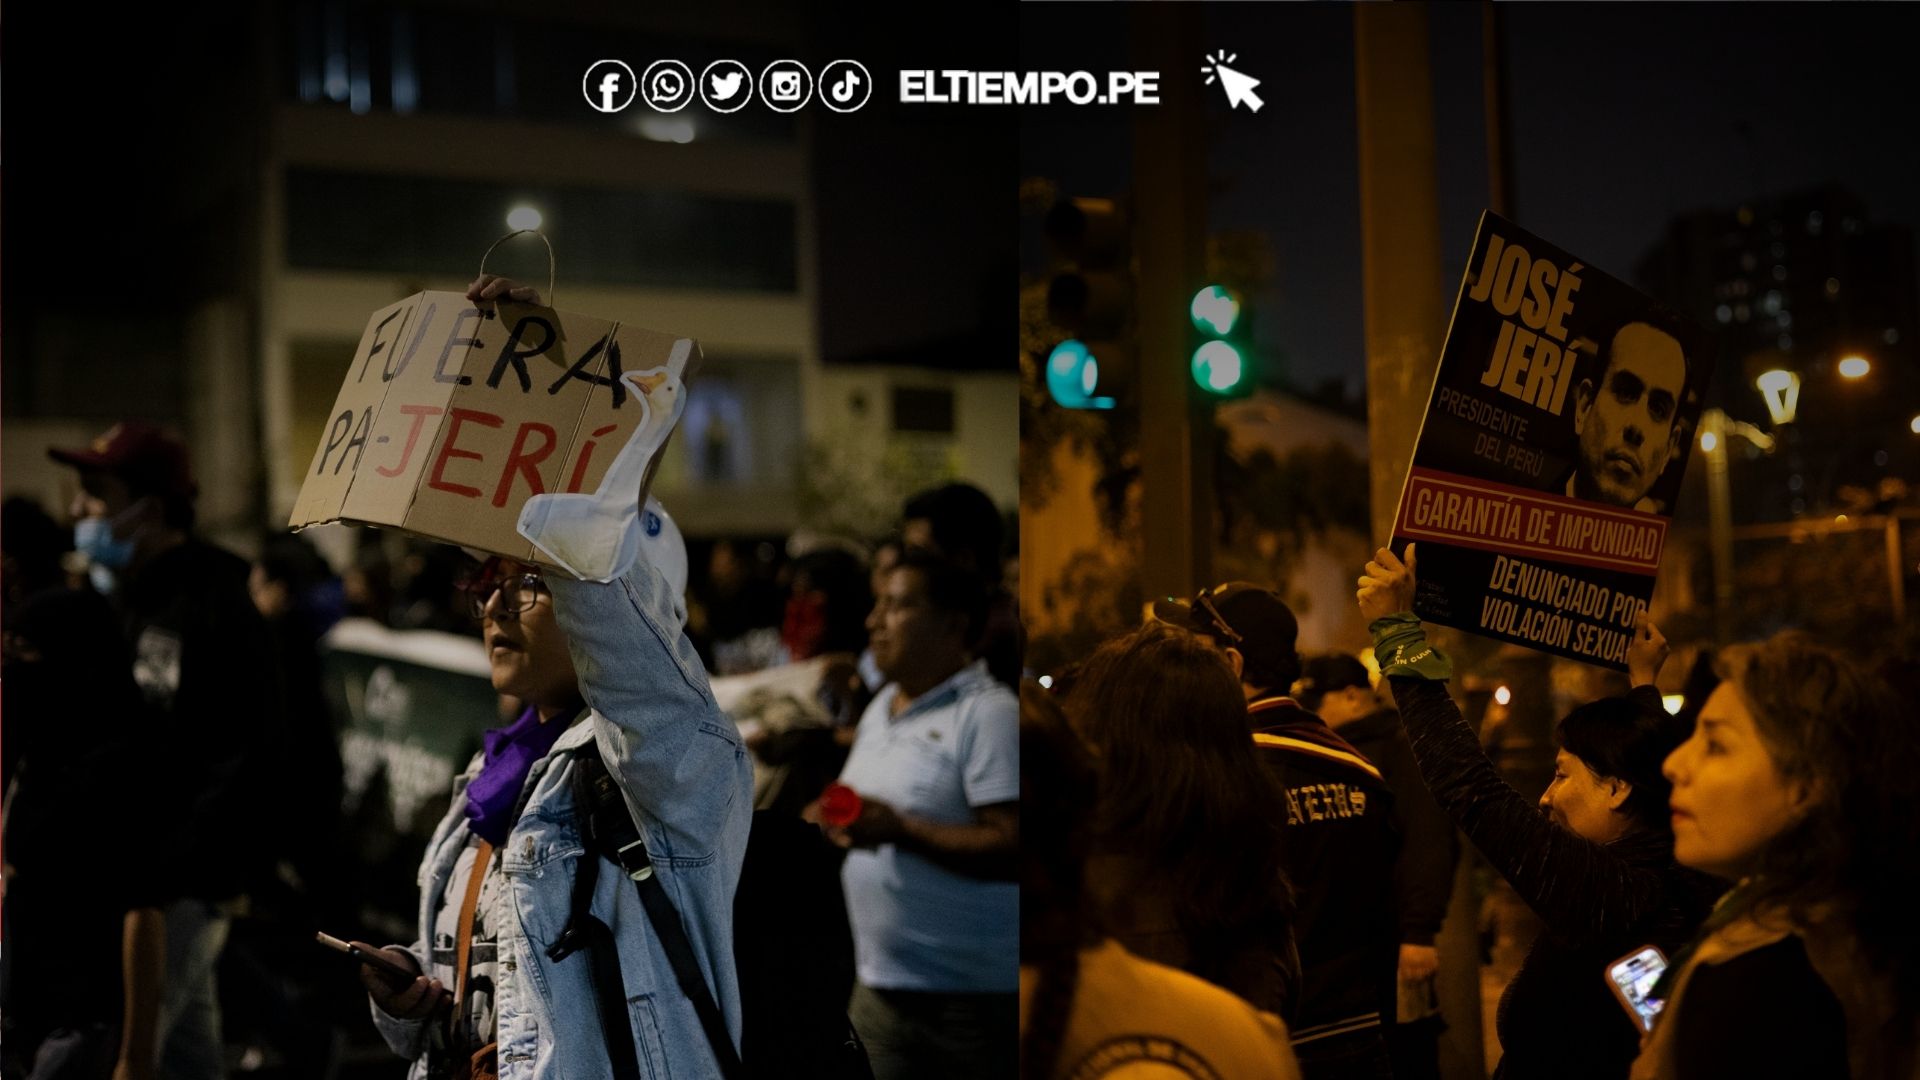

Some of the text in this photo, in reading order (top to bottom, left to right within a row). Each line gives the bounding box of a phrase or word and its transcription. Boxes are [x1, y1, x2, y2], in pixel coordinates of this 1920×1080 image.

[1468, 233, 1585, 342] JOSÉ
[358, 302, 627, 409] FUERA
[1480, 319, 1579, 416] JERÍ
[1436, 386, 1529, 442] PRESIDENTE
[1473, 432, 1545, 477] DEL PERÚ
[1414, 487, 1658, 560] GARANTÍA DE IMPUNIDAD
[1479, 595, 1573, 650] VIOLACIÓN
[1488, 554, 1609, 621] DENUNCIADO
